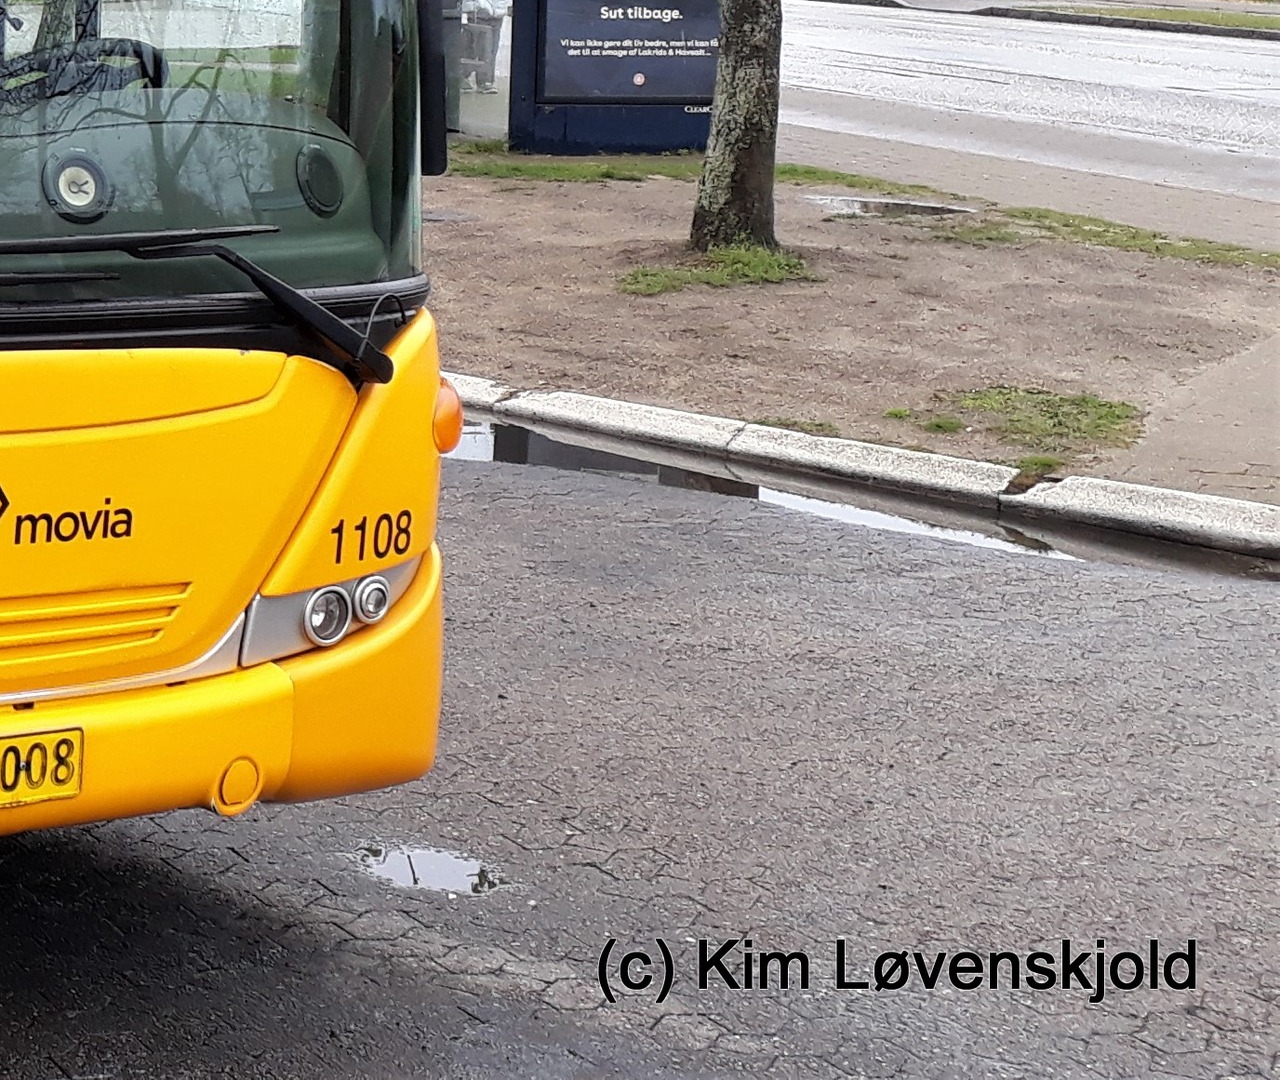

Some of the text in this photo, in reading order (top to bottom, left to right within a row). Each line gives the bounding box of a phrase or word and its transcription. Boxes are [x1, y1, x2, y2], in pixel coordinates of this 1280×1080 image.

[600, 6, 683, 23] Sut tilbage.
[560, 39, 569, 47] Vi
[570, 39, 585, 47] kan
[694, 39, 709, 47] kan
[668, 48, 674, 56] &
[13, 497, 134, 545] movia
[330, 509, 413, 565] 1108
[0, 737, 76, 792] 008
